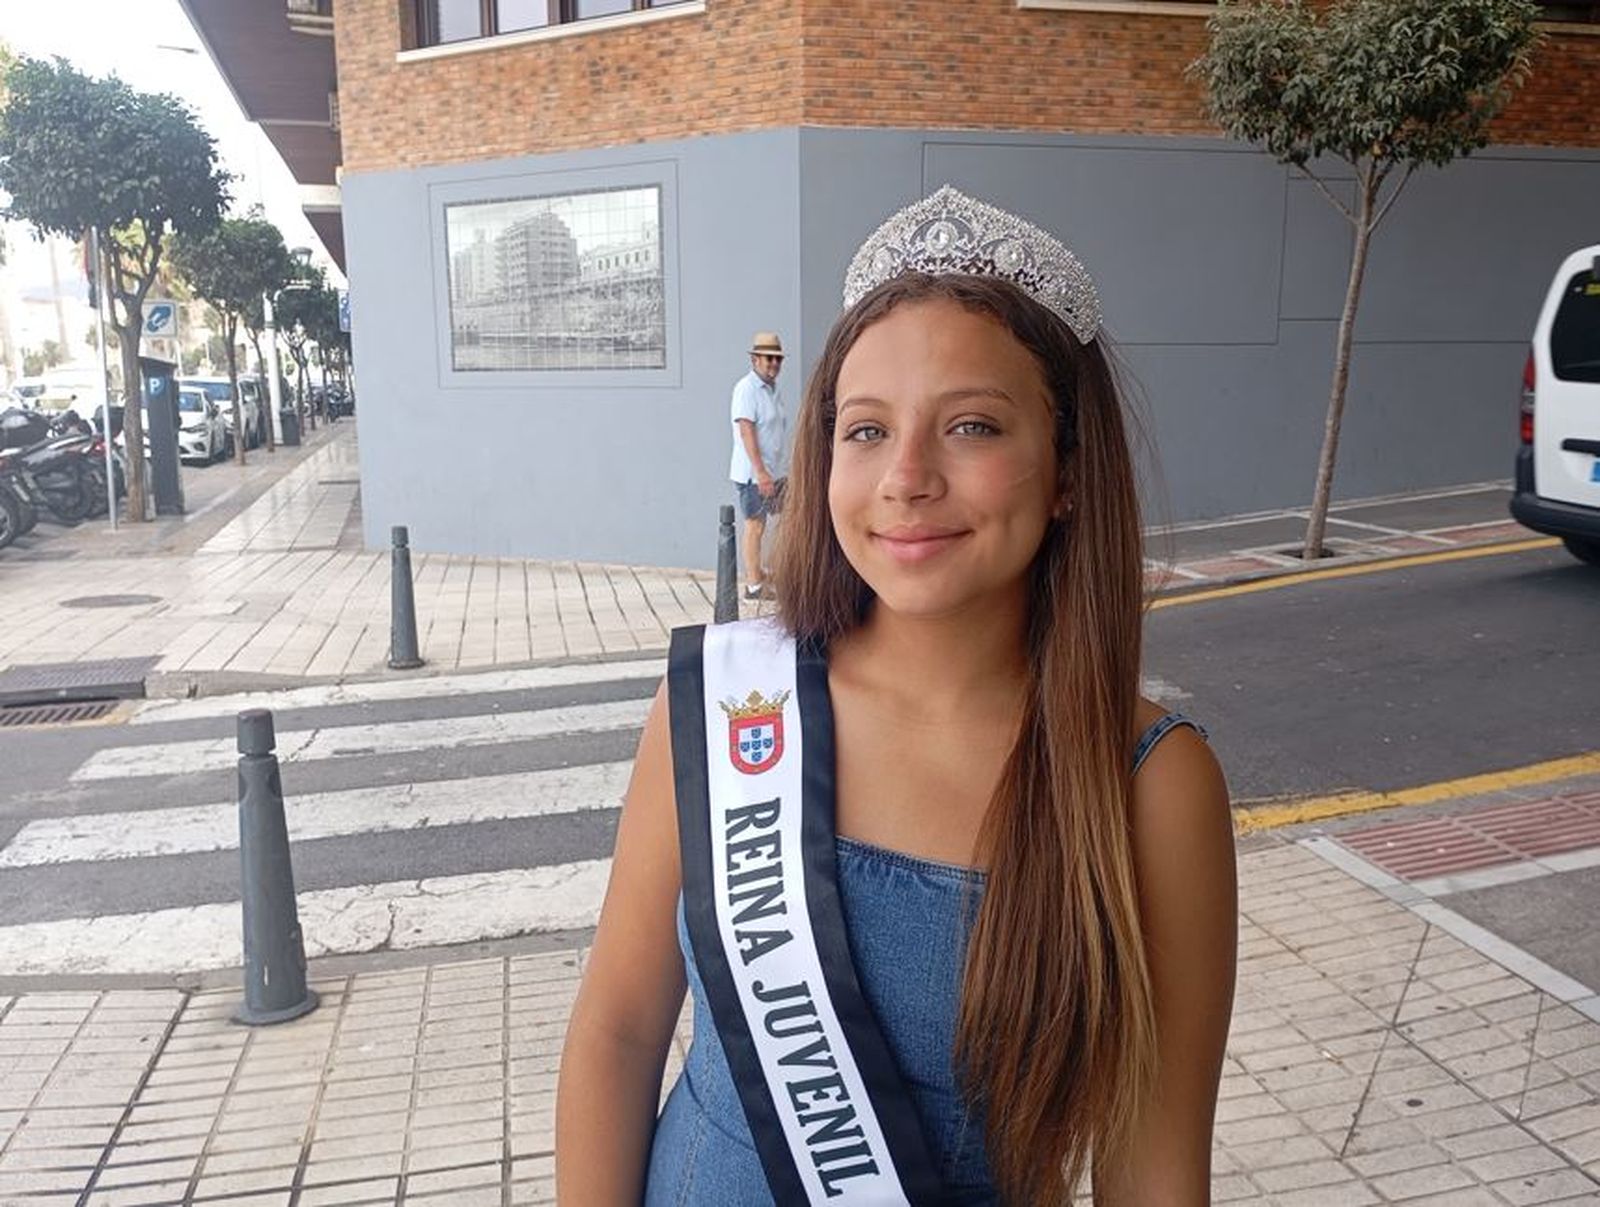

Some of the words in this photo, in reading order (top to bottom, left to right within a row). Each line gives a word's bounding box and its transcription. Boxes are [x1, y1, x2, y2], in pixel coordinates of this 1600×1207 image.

[149, 377, 160, 395] P
[724, 797, 794, 966] REINA
[752, 980, 880, 1198] JUVENIL
